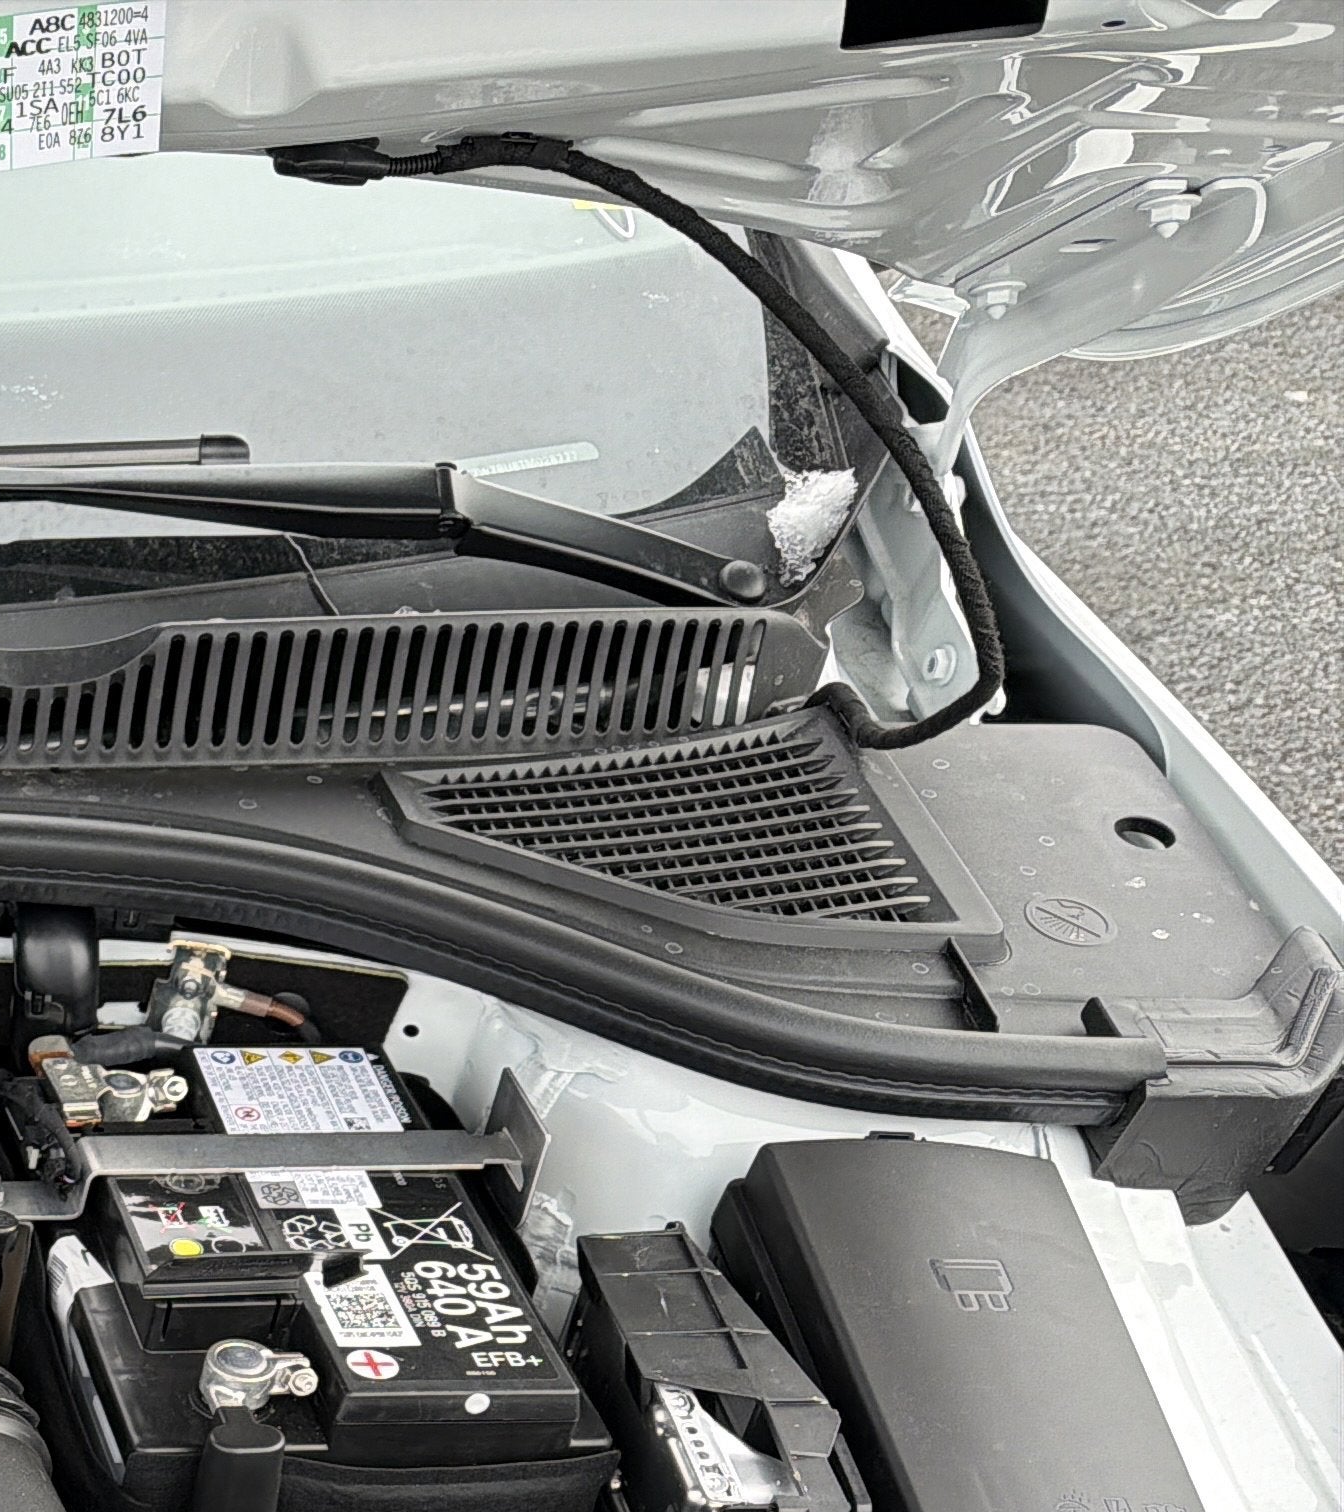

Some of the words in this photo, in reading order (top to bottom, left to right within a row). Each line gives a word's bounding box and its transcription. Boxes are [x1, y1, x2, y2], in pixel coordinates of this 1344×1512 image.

[29, 13, 75, 35] A8C
[0, 27, 8, 45] 5
[4, 37, 52, 58] ACC
[124, 28, 148, 46] 4VA
[38, 57, 61, 76] 4A3
[102, 105, 147, 125] 7L6
[101, 124, 145, 142] 8Y1
[348, 1222, 375, 1243] Pb
[413, 1260, 477, 1316] 640
[445, 1323, 495, 1349] A
[457, 1262, 533, 1345] 59Ah
[470, 1351, 544, 1369] EFB+
